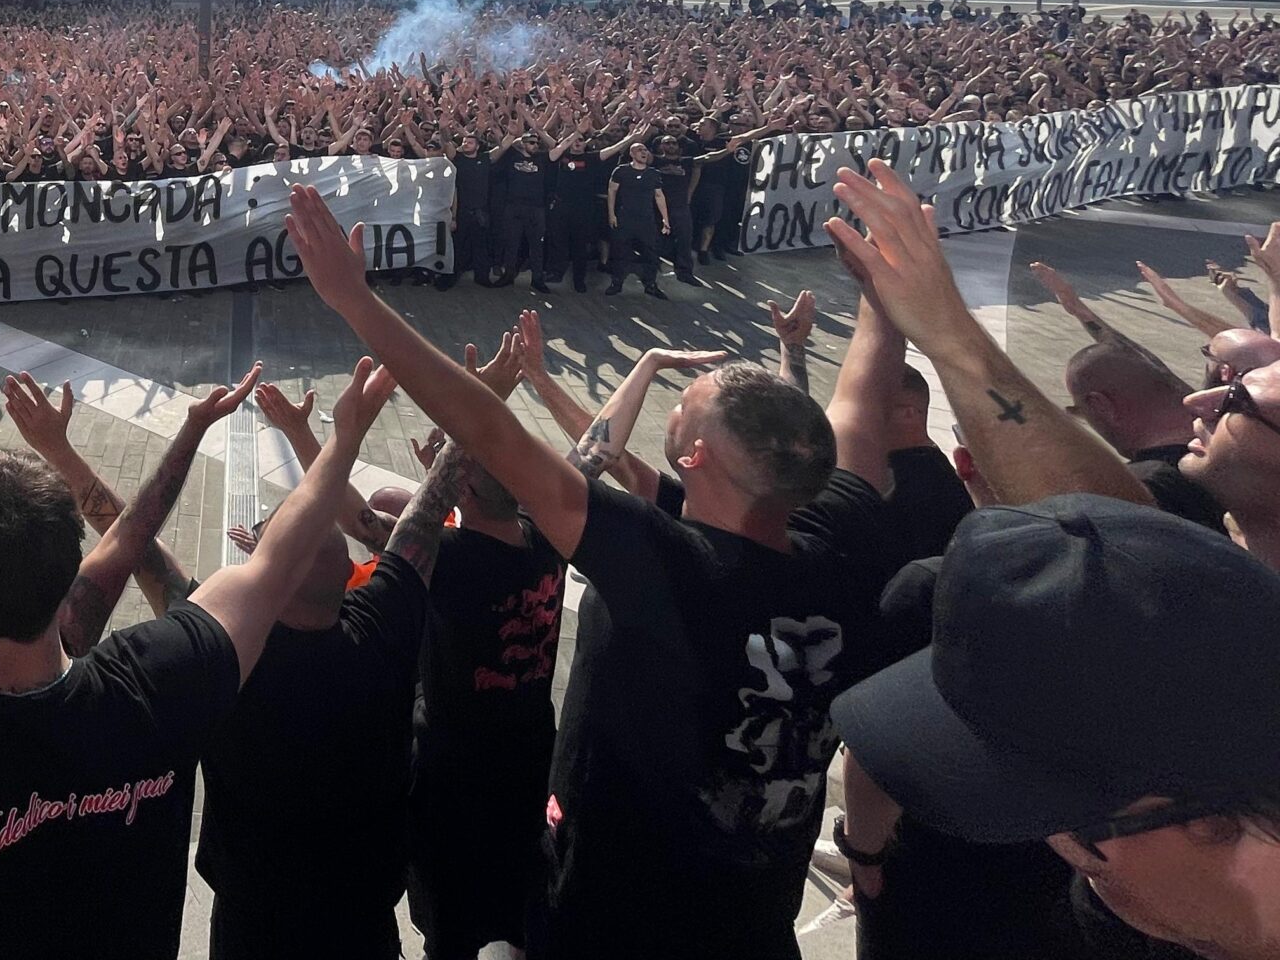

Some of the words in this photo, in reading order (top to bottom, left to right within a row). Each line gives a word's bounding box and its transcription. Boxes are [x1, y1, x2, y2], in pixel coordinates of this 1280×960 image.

[752, 135, 833, 191] CHE
[910, 120, 1006, 174] PRIMA
[0, 174, 221, 233] MONCADA
[740, 200, 818, 254] CON
[35, 241, 218, 298] QUESTA
[245, 222, 415, 282] AGIA
[78, 782, 131, 817] miei
